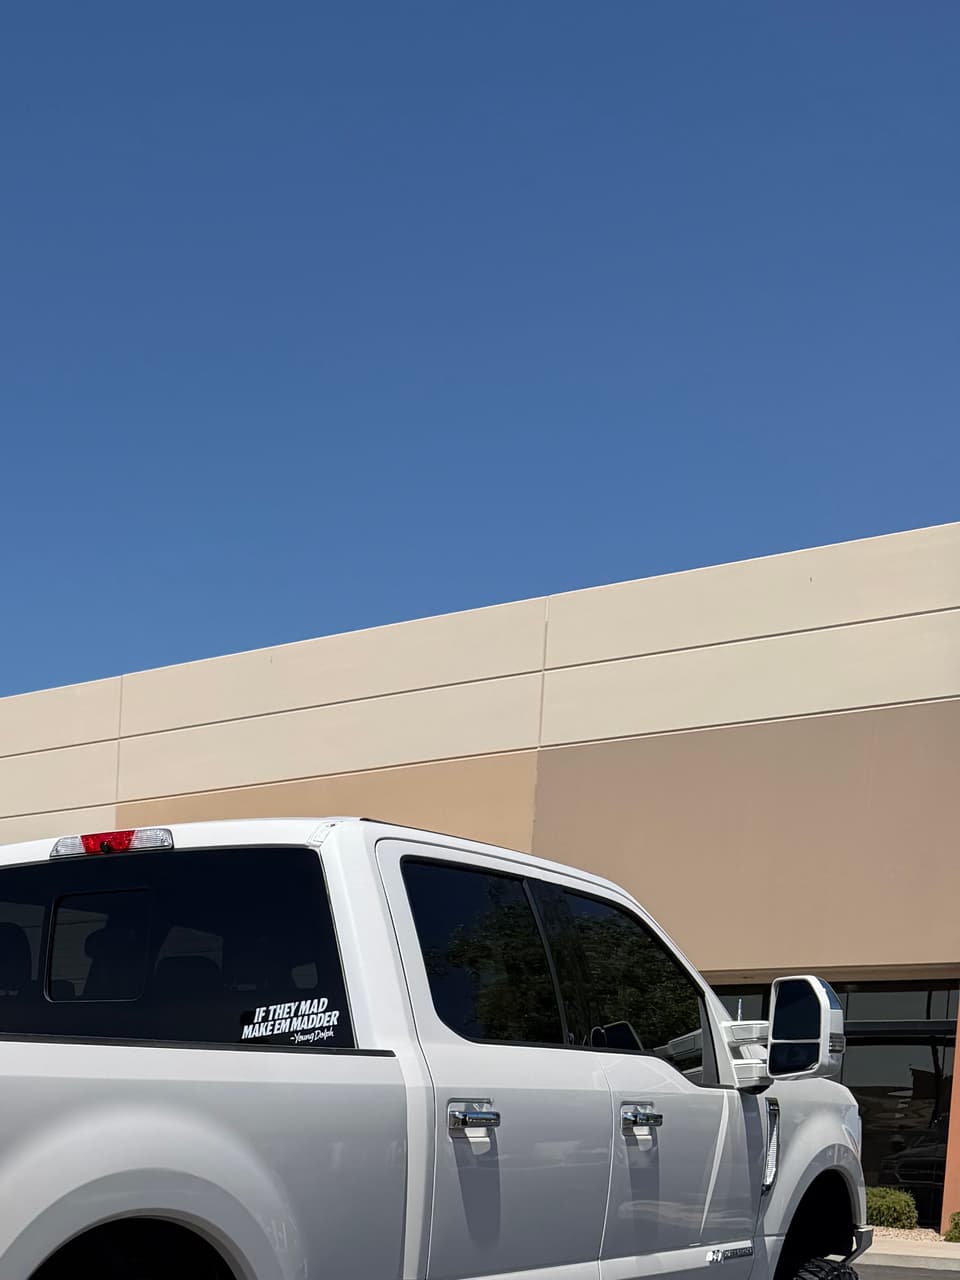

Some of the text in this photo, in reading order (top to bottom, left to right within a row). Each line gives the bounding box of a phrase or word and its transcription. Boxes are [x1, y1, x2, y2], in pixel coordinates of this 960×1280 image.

[253, 998, 328, 1023] IF THEY MAD
[241, 1011, 339, 1039] MAKE EM MADDER
[314, 1027, 334, 1041] Dolph
